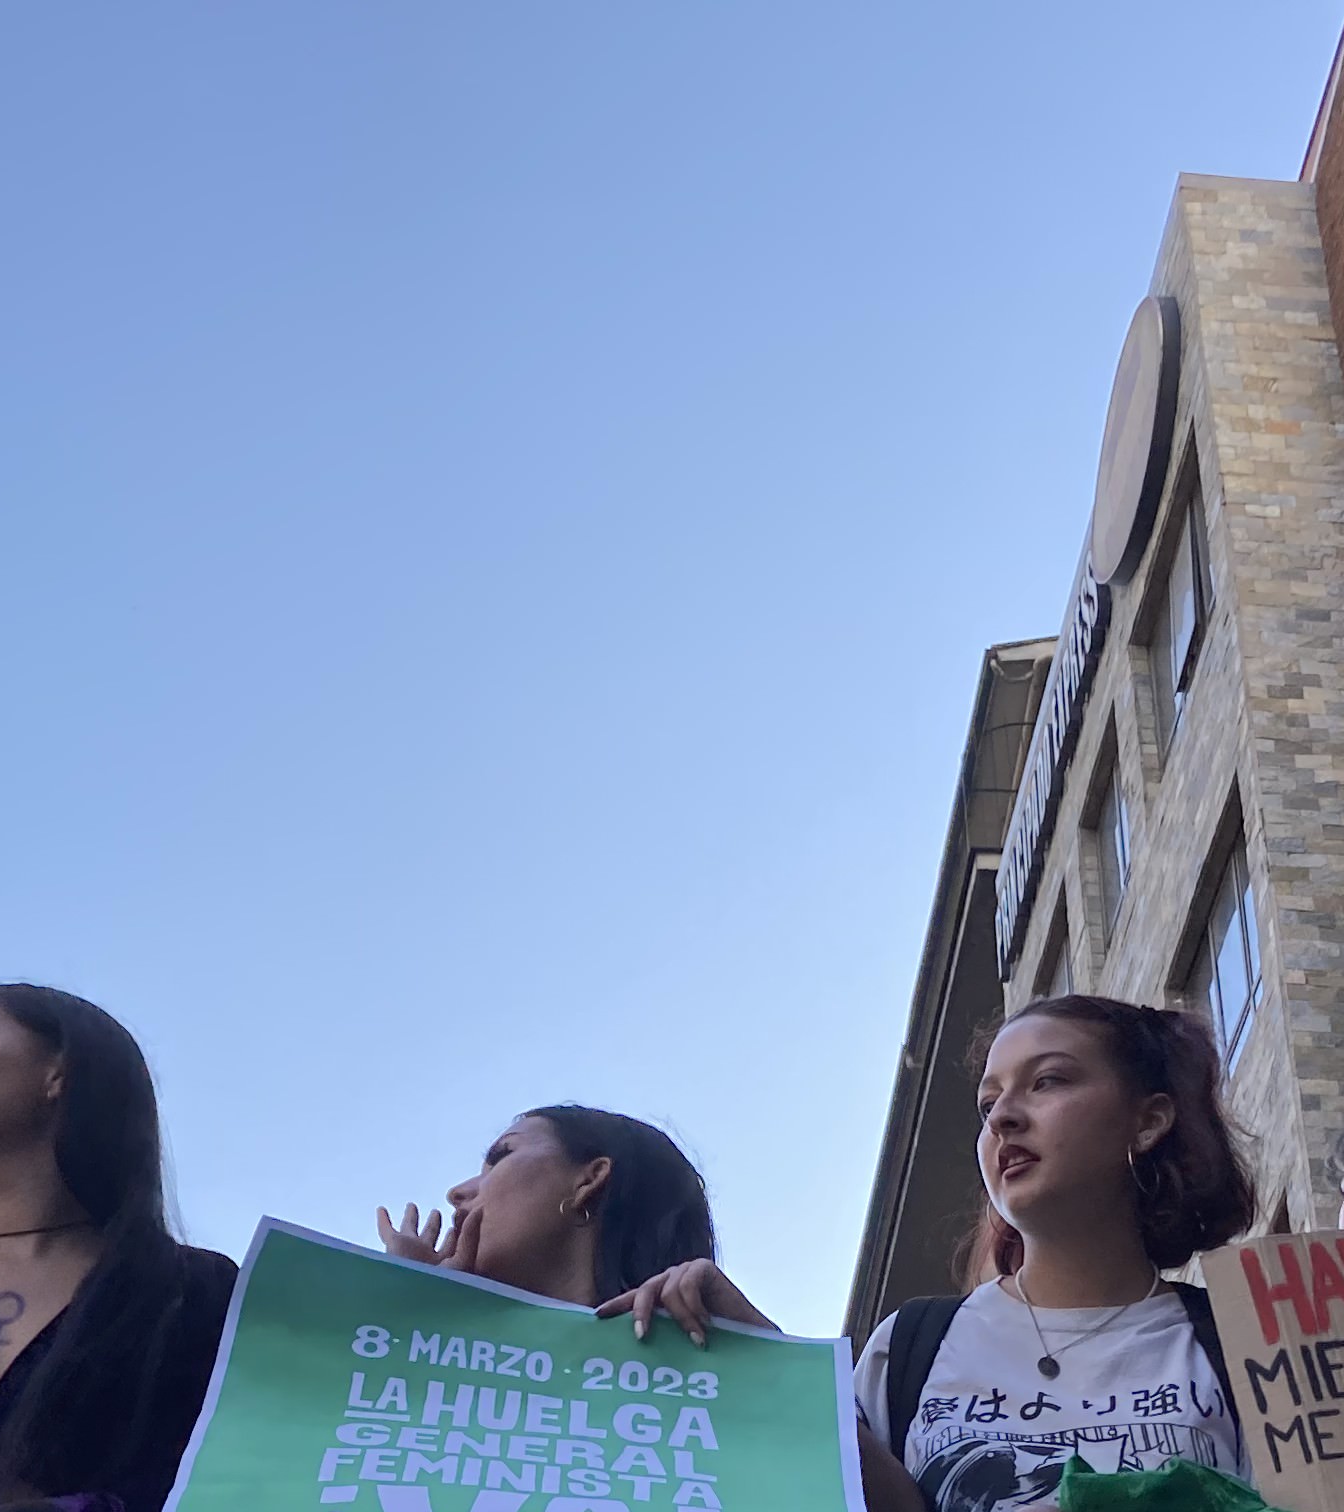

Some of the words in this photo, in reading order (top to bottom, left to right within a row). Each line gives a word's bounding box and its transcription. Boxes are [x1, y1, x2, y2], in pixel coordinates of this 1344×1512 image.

[408, 1331, 553, 1383] MARZO
[581, 1358, 720, 1400] 2023
[346, 1371, 409, 1420] LA
[422, 1382, 719, 1450] HUELGA
[317, 1448, 722, 1510] FEMINISTA
[335, 1424, 718, 1482] GENERAL
